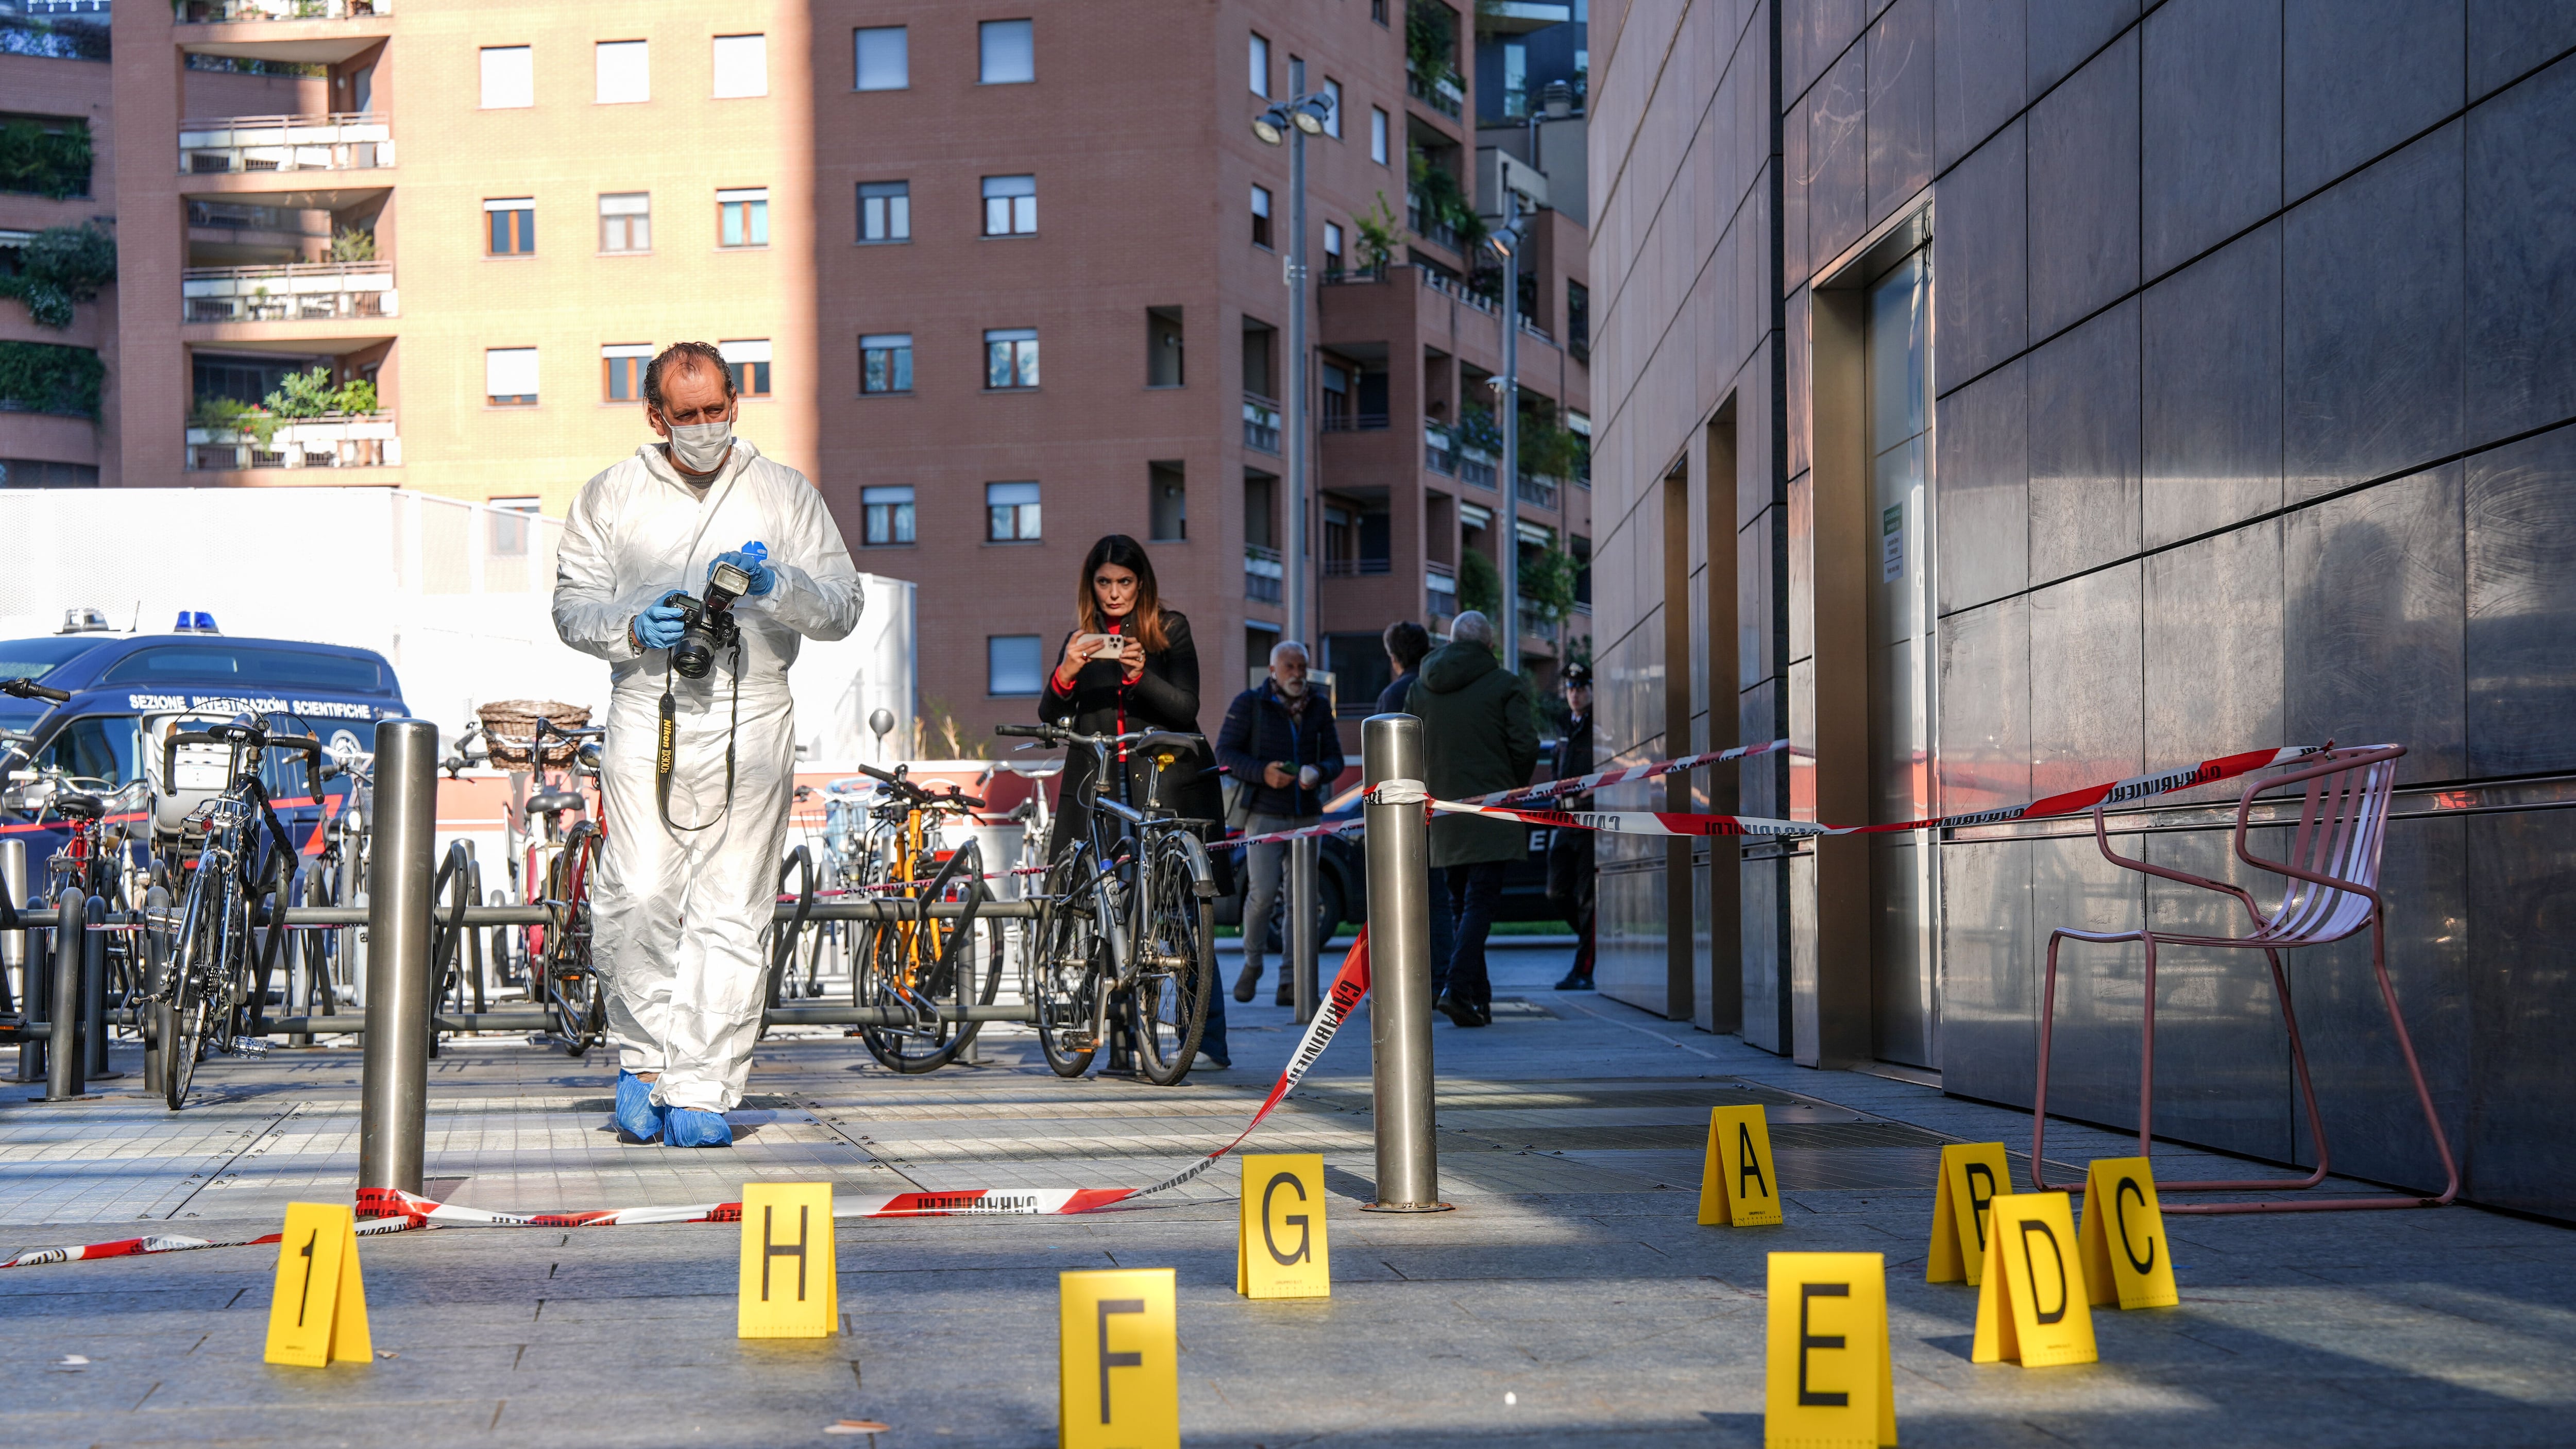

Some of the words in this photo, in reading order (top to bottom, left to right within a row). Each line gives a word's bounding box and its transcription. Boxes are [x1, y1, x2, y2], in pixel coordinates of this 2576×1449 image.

[129, 695, 187, 709] SEZIONE
[193, 696, 289, 713] INVESTIGAZIONI
[293, 700, 371, 719] SCIENTIFICHE
[663, 719, 671, 748] Nikon
[1286, 980, 1362, 1085] CARABINIERI
[1739, 1122, 1768, 1199] A
[761, 1205, 808, 1301] H
[1262, 1172, 1311, 1266] G
[2116, 1177, 2154, 1275] C
[300, 1228, 317, 1327] 1
[2019, 1220, 2067, 1325] D
[1098, 1300, 1144, 1424] F
[1799, 1284, 1849, 1406] E
